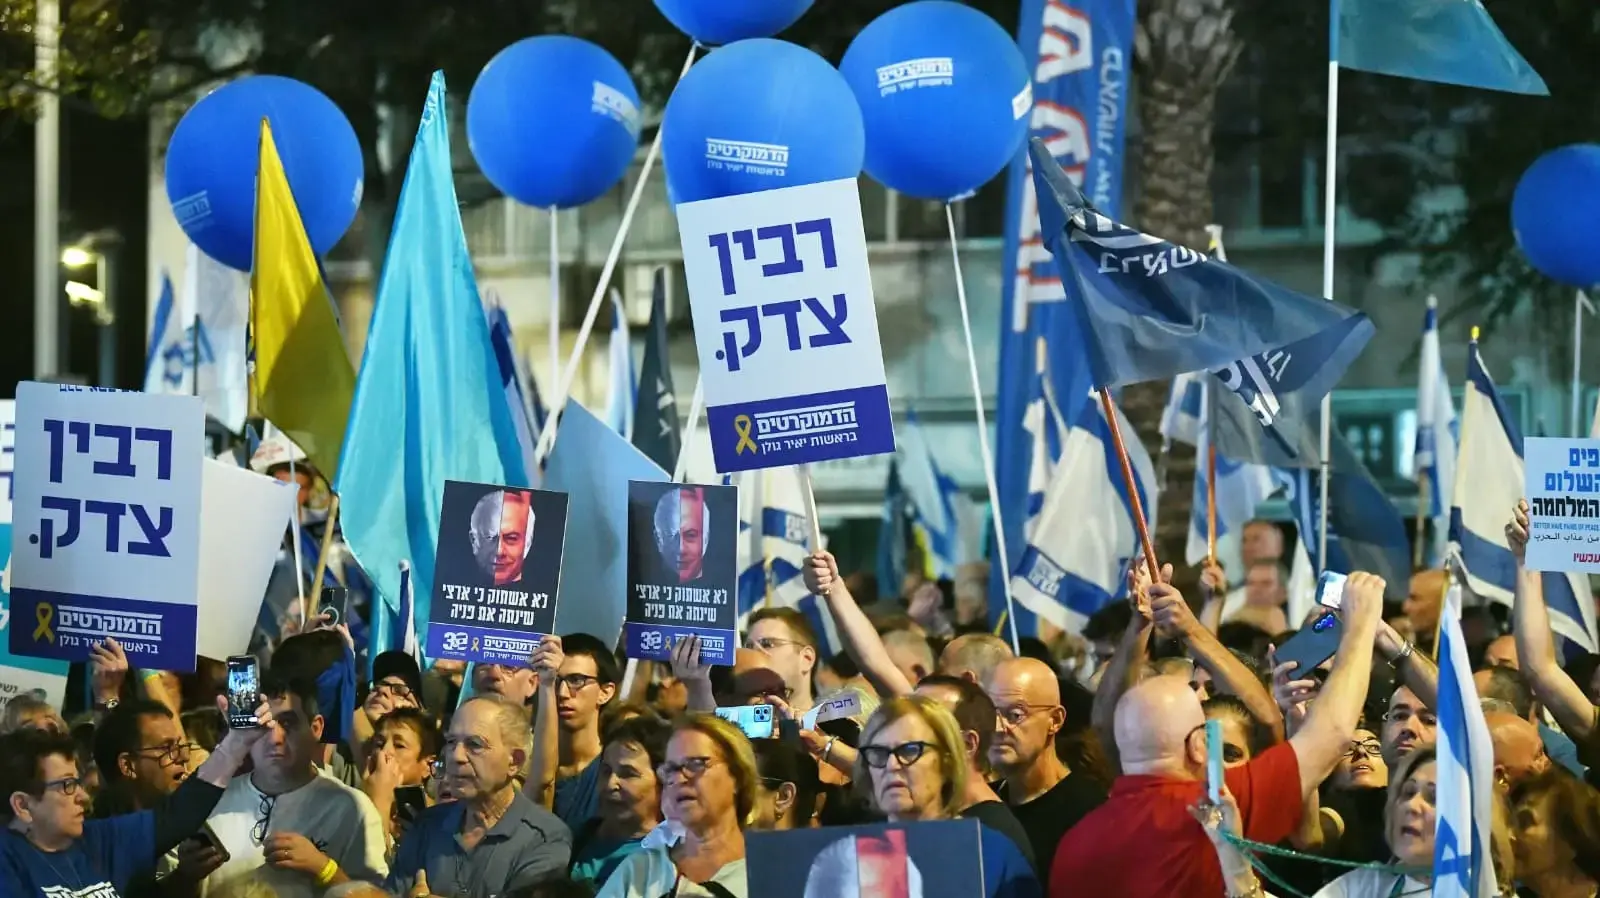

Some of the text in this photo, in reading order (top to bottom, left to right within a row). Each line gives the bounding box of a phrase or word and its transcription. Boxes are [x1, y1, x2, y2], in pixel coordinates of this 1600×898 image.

[707, 143, 788, 162] הדמוקרטים
[709, 218, 838, 295] רבין
[715, 293, 853, 372] צדק.
[756, 407, 857, 433] הדמוקרטים
[43, 419, 172, 483] רבין
[761, 431, 857, 455] בראשות יאיר גולן
[1545, 470, 1600, 492] השלום
[1532, 495, 1600, 518] המלחמה
[29, 495, 173, 559] צדק.
[442, 583, 549, 608] לא אשתוק כי ארצי
[636, 584, 728, 605] לא אשתוק כי ארצי
[59, 611, 161, 634] הדמוקרטים
[450, 603, 535, 626] שינתה את פניה
[645, 603, 717, 622] שינתה את פניה
[59, 634, 80, 648] גולן
[118, 641, 159, 654] בראש
